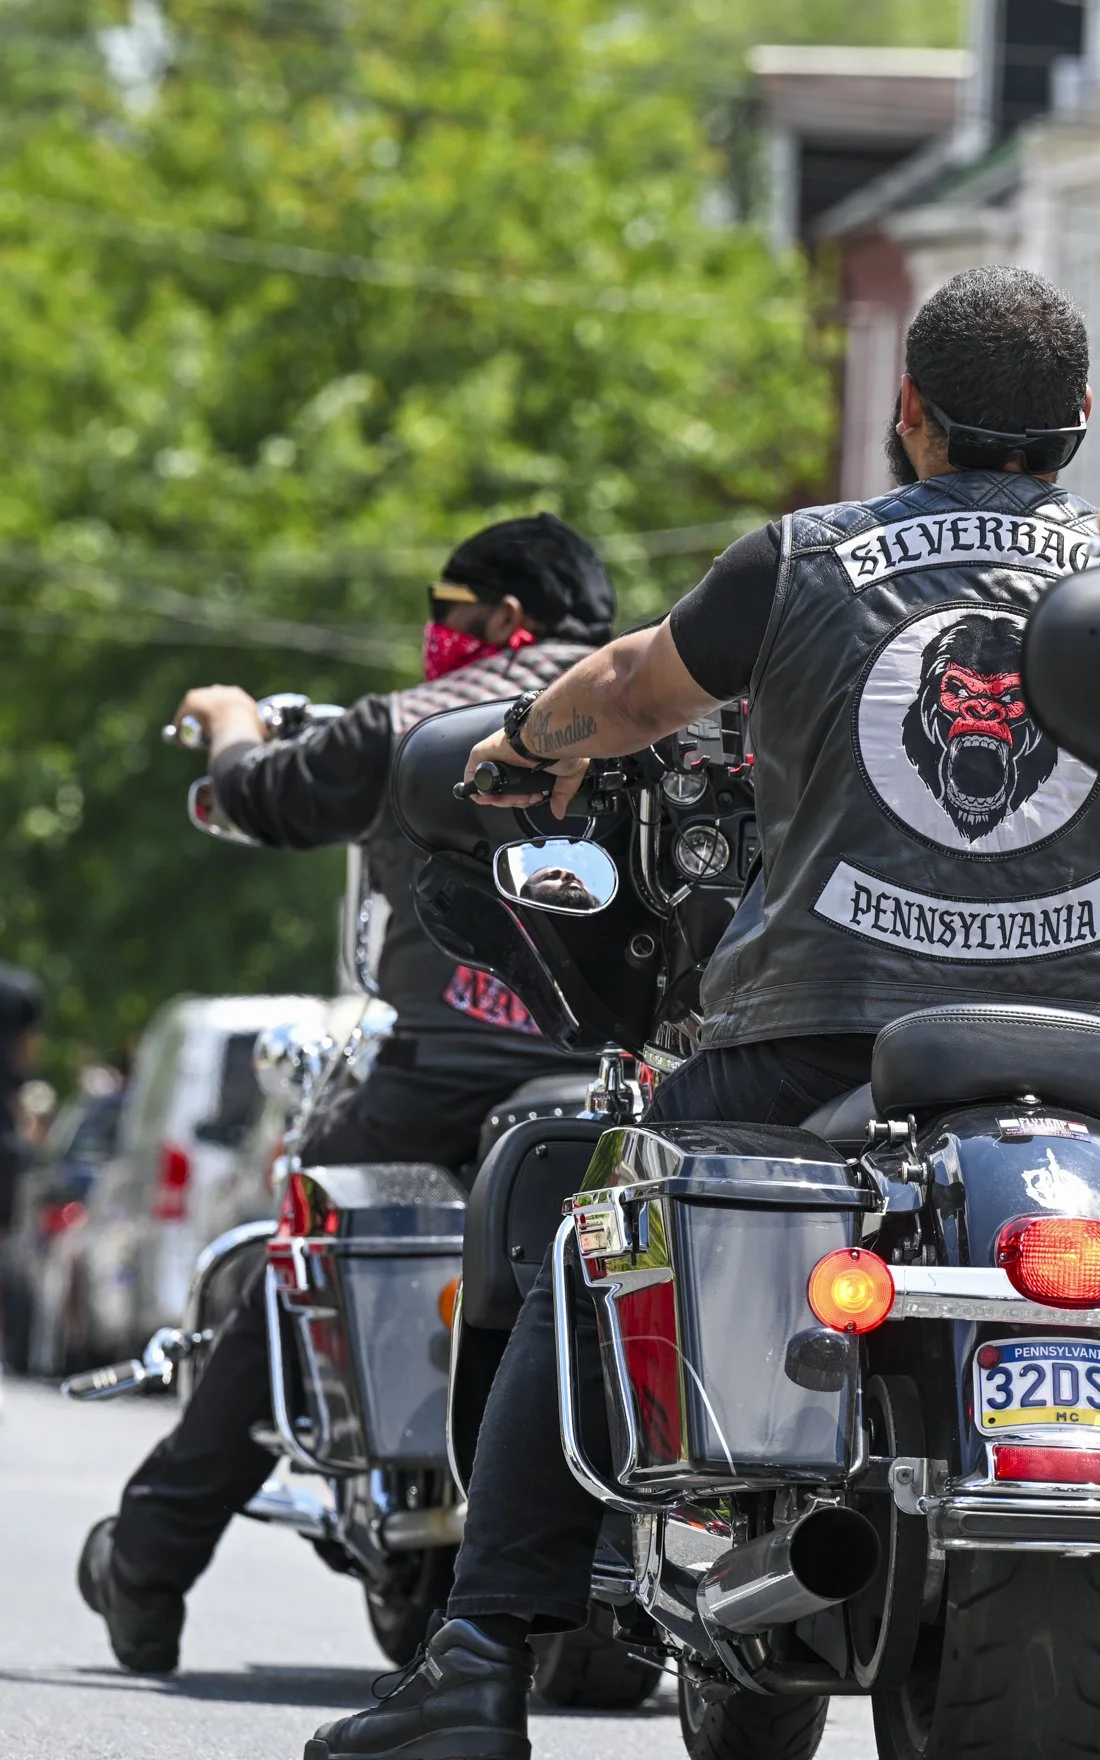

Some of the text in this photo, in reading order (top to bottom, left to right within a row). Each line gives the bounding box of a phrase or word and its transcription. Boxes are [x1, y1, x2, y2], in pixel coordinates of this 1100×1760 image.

[850, 513, 1094, 576] SILVERBAC
[850, 881, 1098, 952] PENNSYLVANIA
[1055, 1411, 1080, 1422] MC
